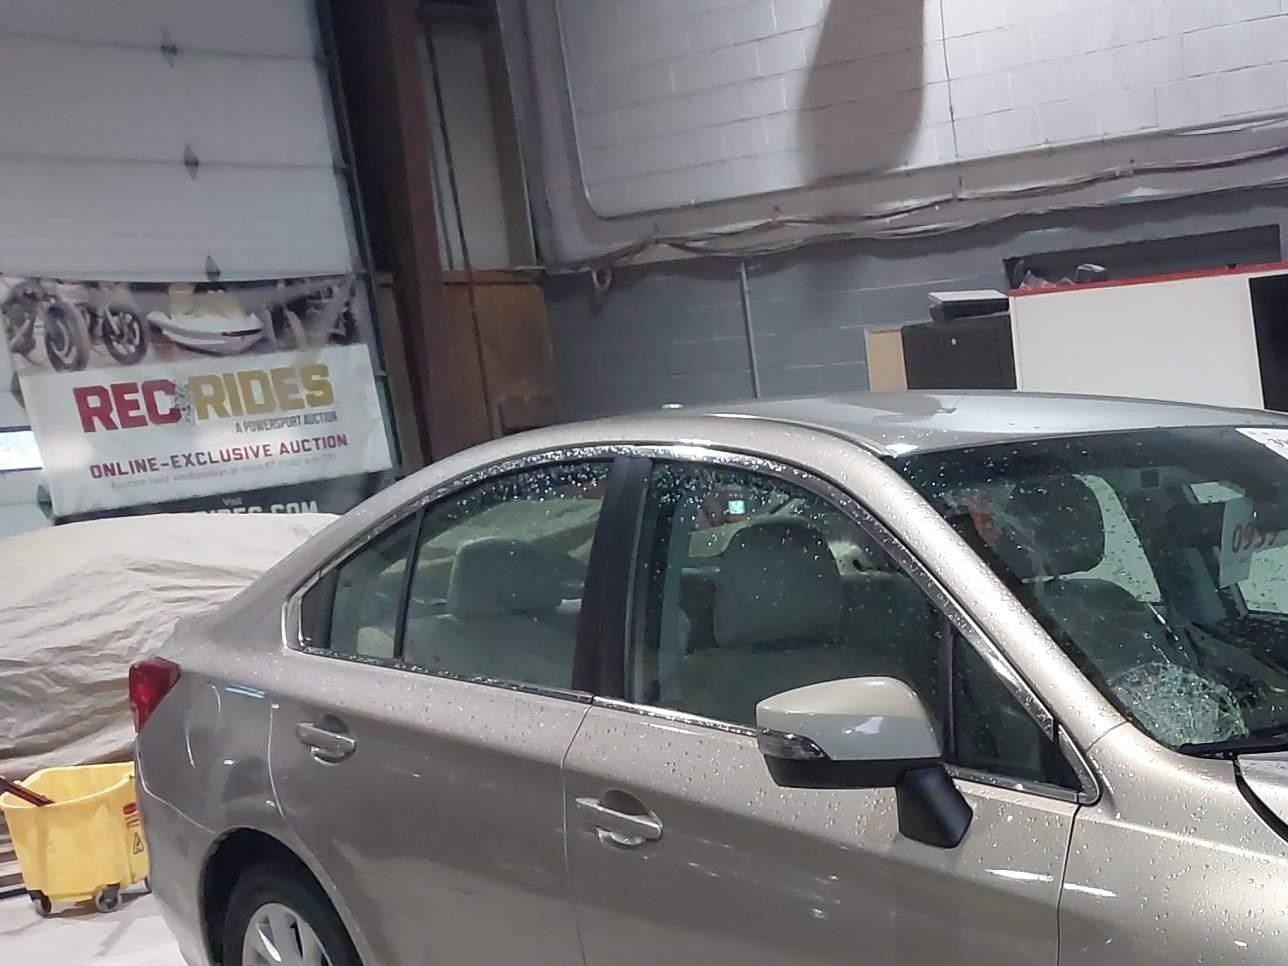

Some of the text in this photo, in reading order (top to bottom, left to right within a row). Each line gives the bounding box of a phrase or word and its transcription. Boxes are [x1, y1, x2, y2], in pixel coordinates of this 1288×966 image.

[72, 363, 335, 433] REC RIDES
[235, 410, 338, 434] A POWERSPORT AUCTION
[90, 443, 273, 479] ONLINE-EXCLUSIVE
[279, 433, 349, 456] AUCTION
